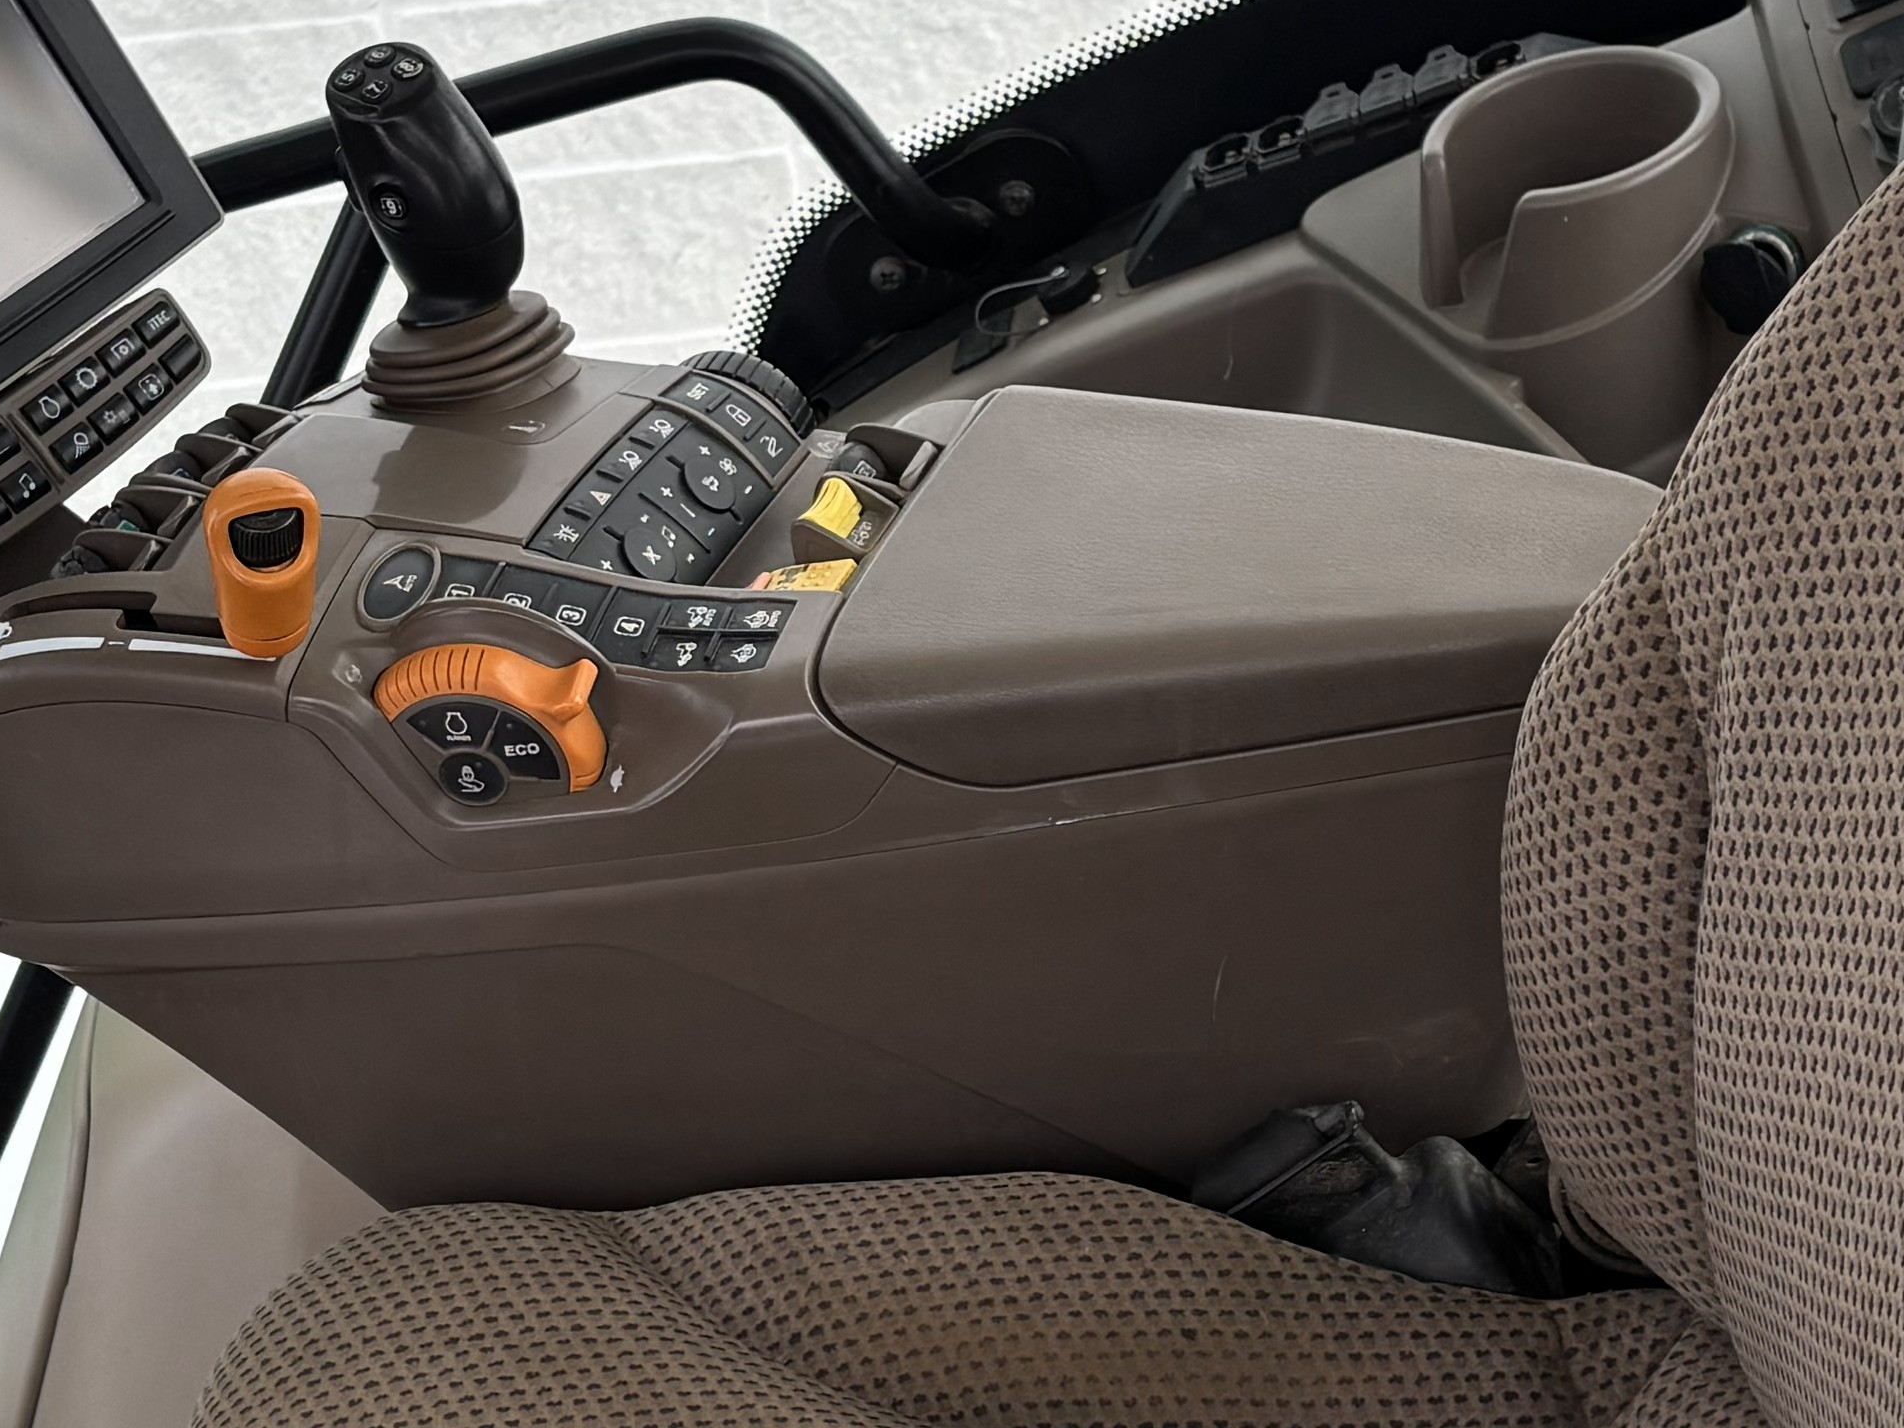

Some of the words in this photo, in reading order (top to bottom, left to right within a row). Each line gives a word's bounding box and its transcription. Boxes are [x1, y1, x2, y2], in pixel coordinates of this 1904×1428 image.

[561, 610, 581, 621] 3
[620, 621, 640, 632] 4
[504, 743, 540, 757] ECO
